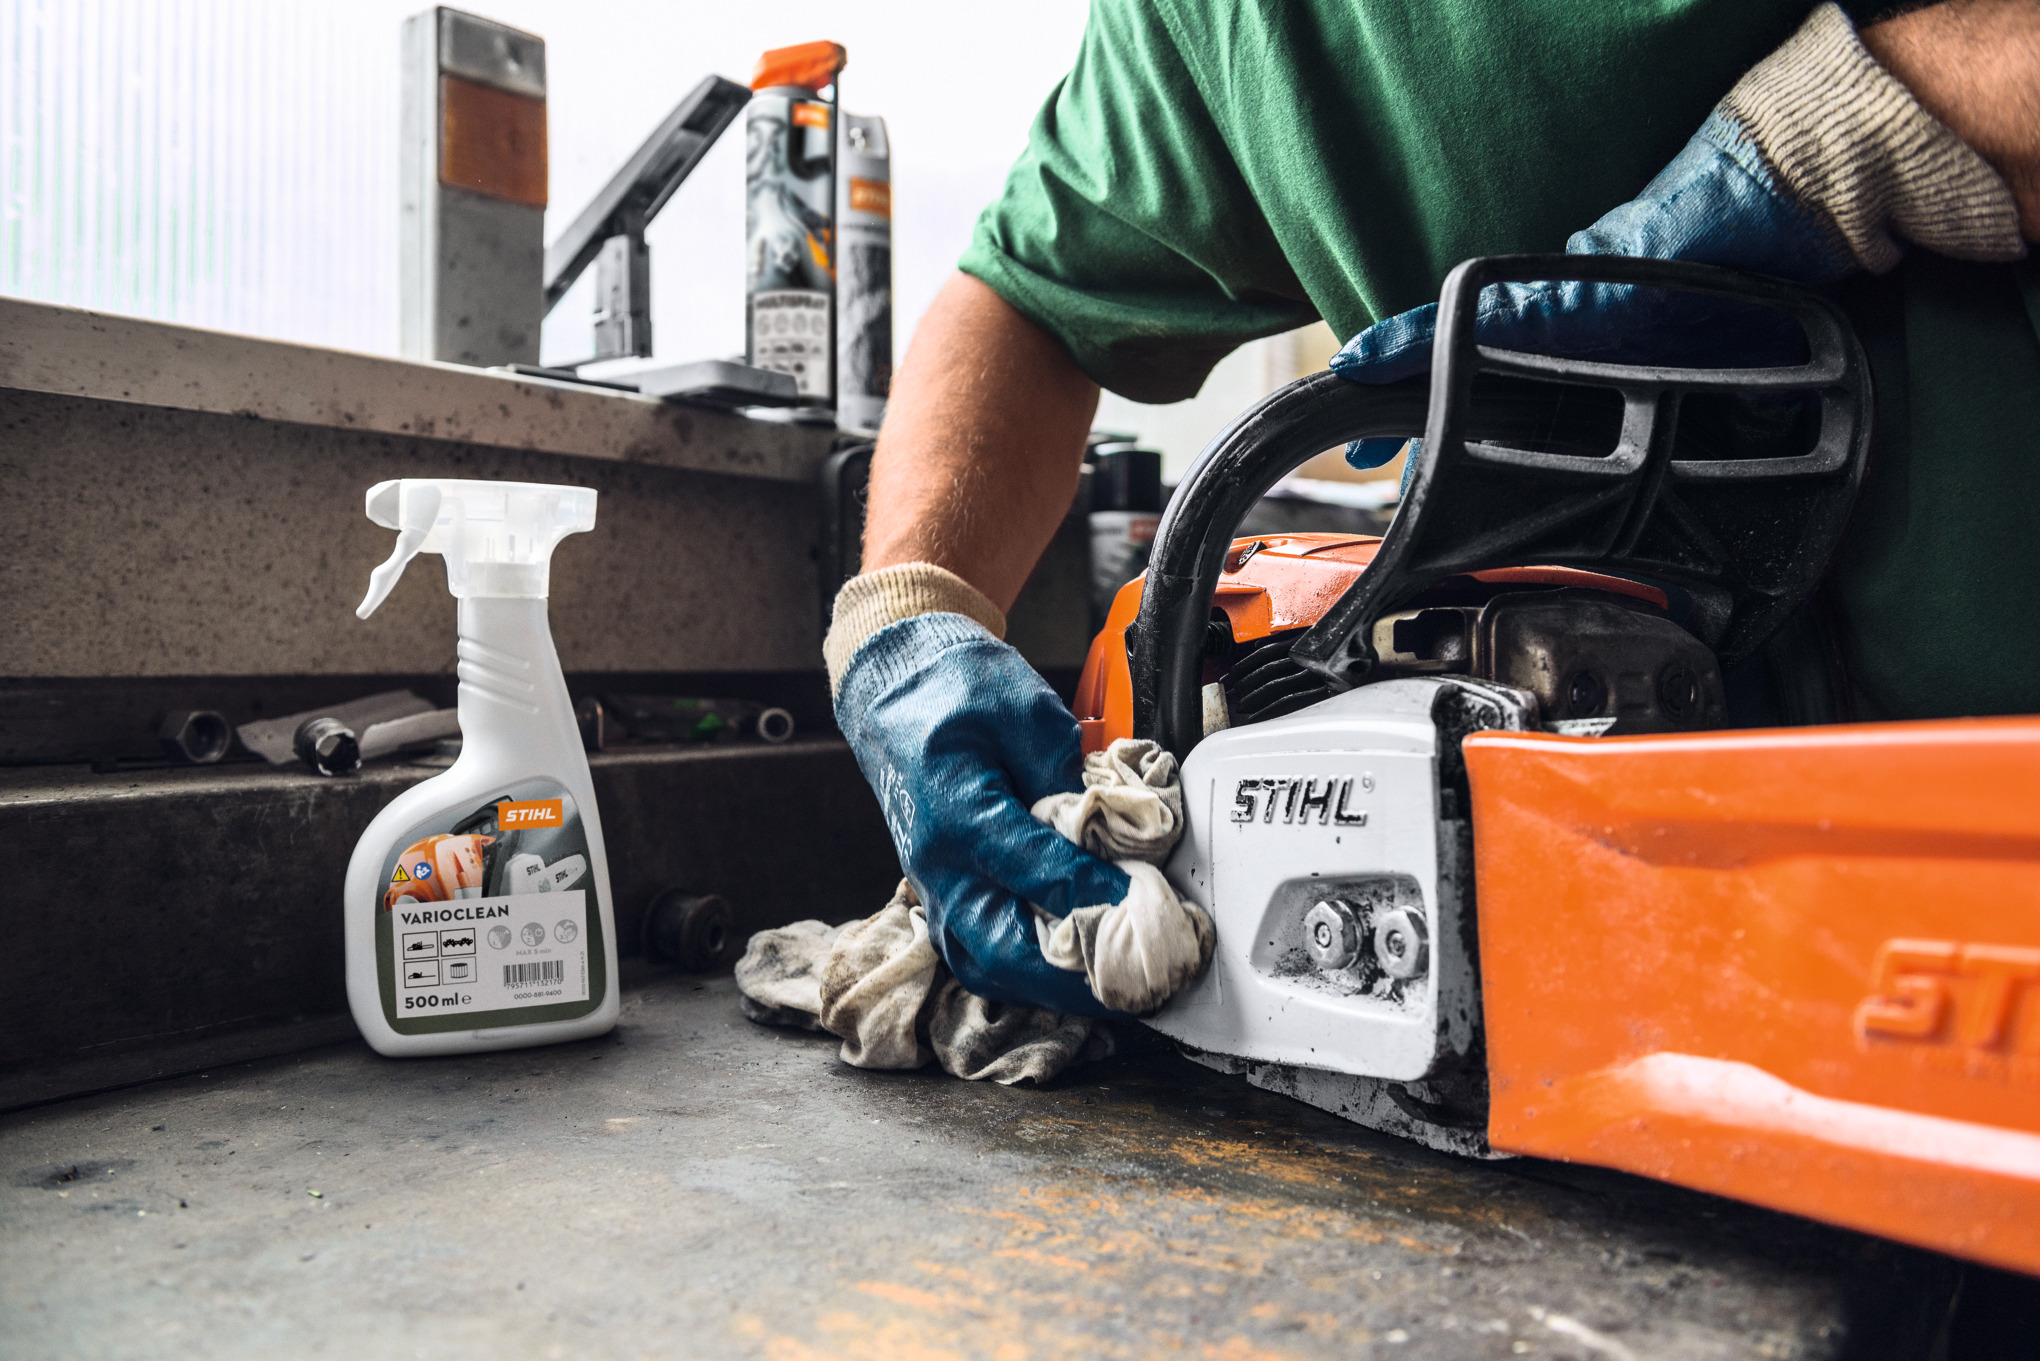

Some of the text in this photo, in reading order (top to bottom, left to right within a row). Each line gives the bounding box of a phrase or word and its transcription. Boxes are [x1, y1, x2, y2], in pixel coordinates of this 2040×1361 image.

[1230, 774, 1367, 827] STIHL
[505, 807, 556, 822] STIHL
[401, 904, 509, 925] VARIOCLEAN
[405, 995, 439, 1009] 500
[441, 992, 458, 1006] ml
[513, 989, 562, 1000] 0000-881-9400
